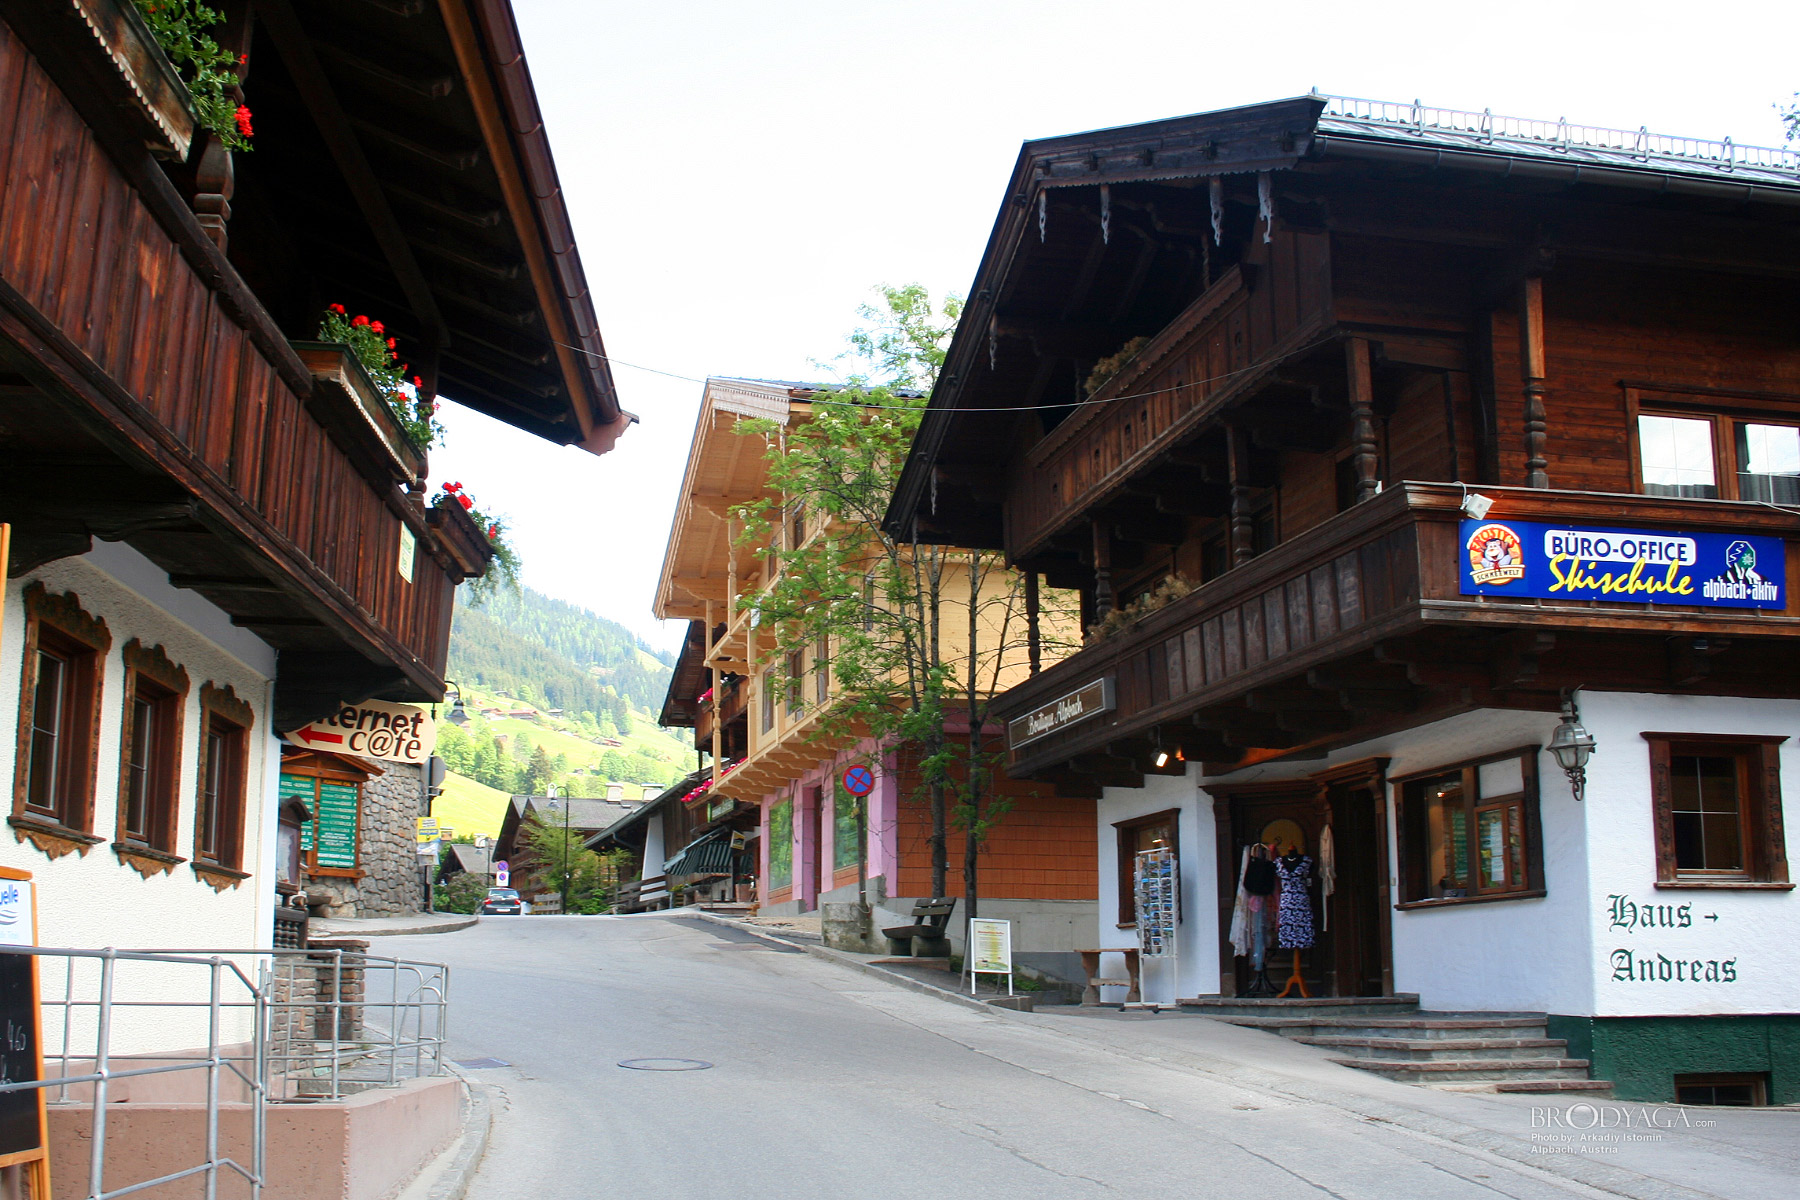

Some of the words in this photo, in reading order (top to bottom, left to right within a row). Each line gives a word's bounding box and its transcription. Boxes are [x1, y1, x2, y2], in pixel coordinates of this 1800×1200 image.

[1552, 532, 1688, 562] BÜRO-OFFICE
[1548, 553, 1694, 595] Skischule
[1606, 894, 1692, 934] Haus
[1610, 948, 1737, 982] Andreas
